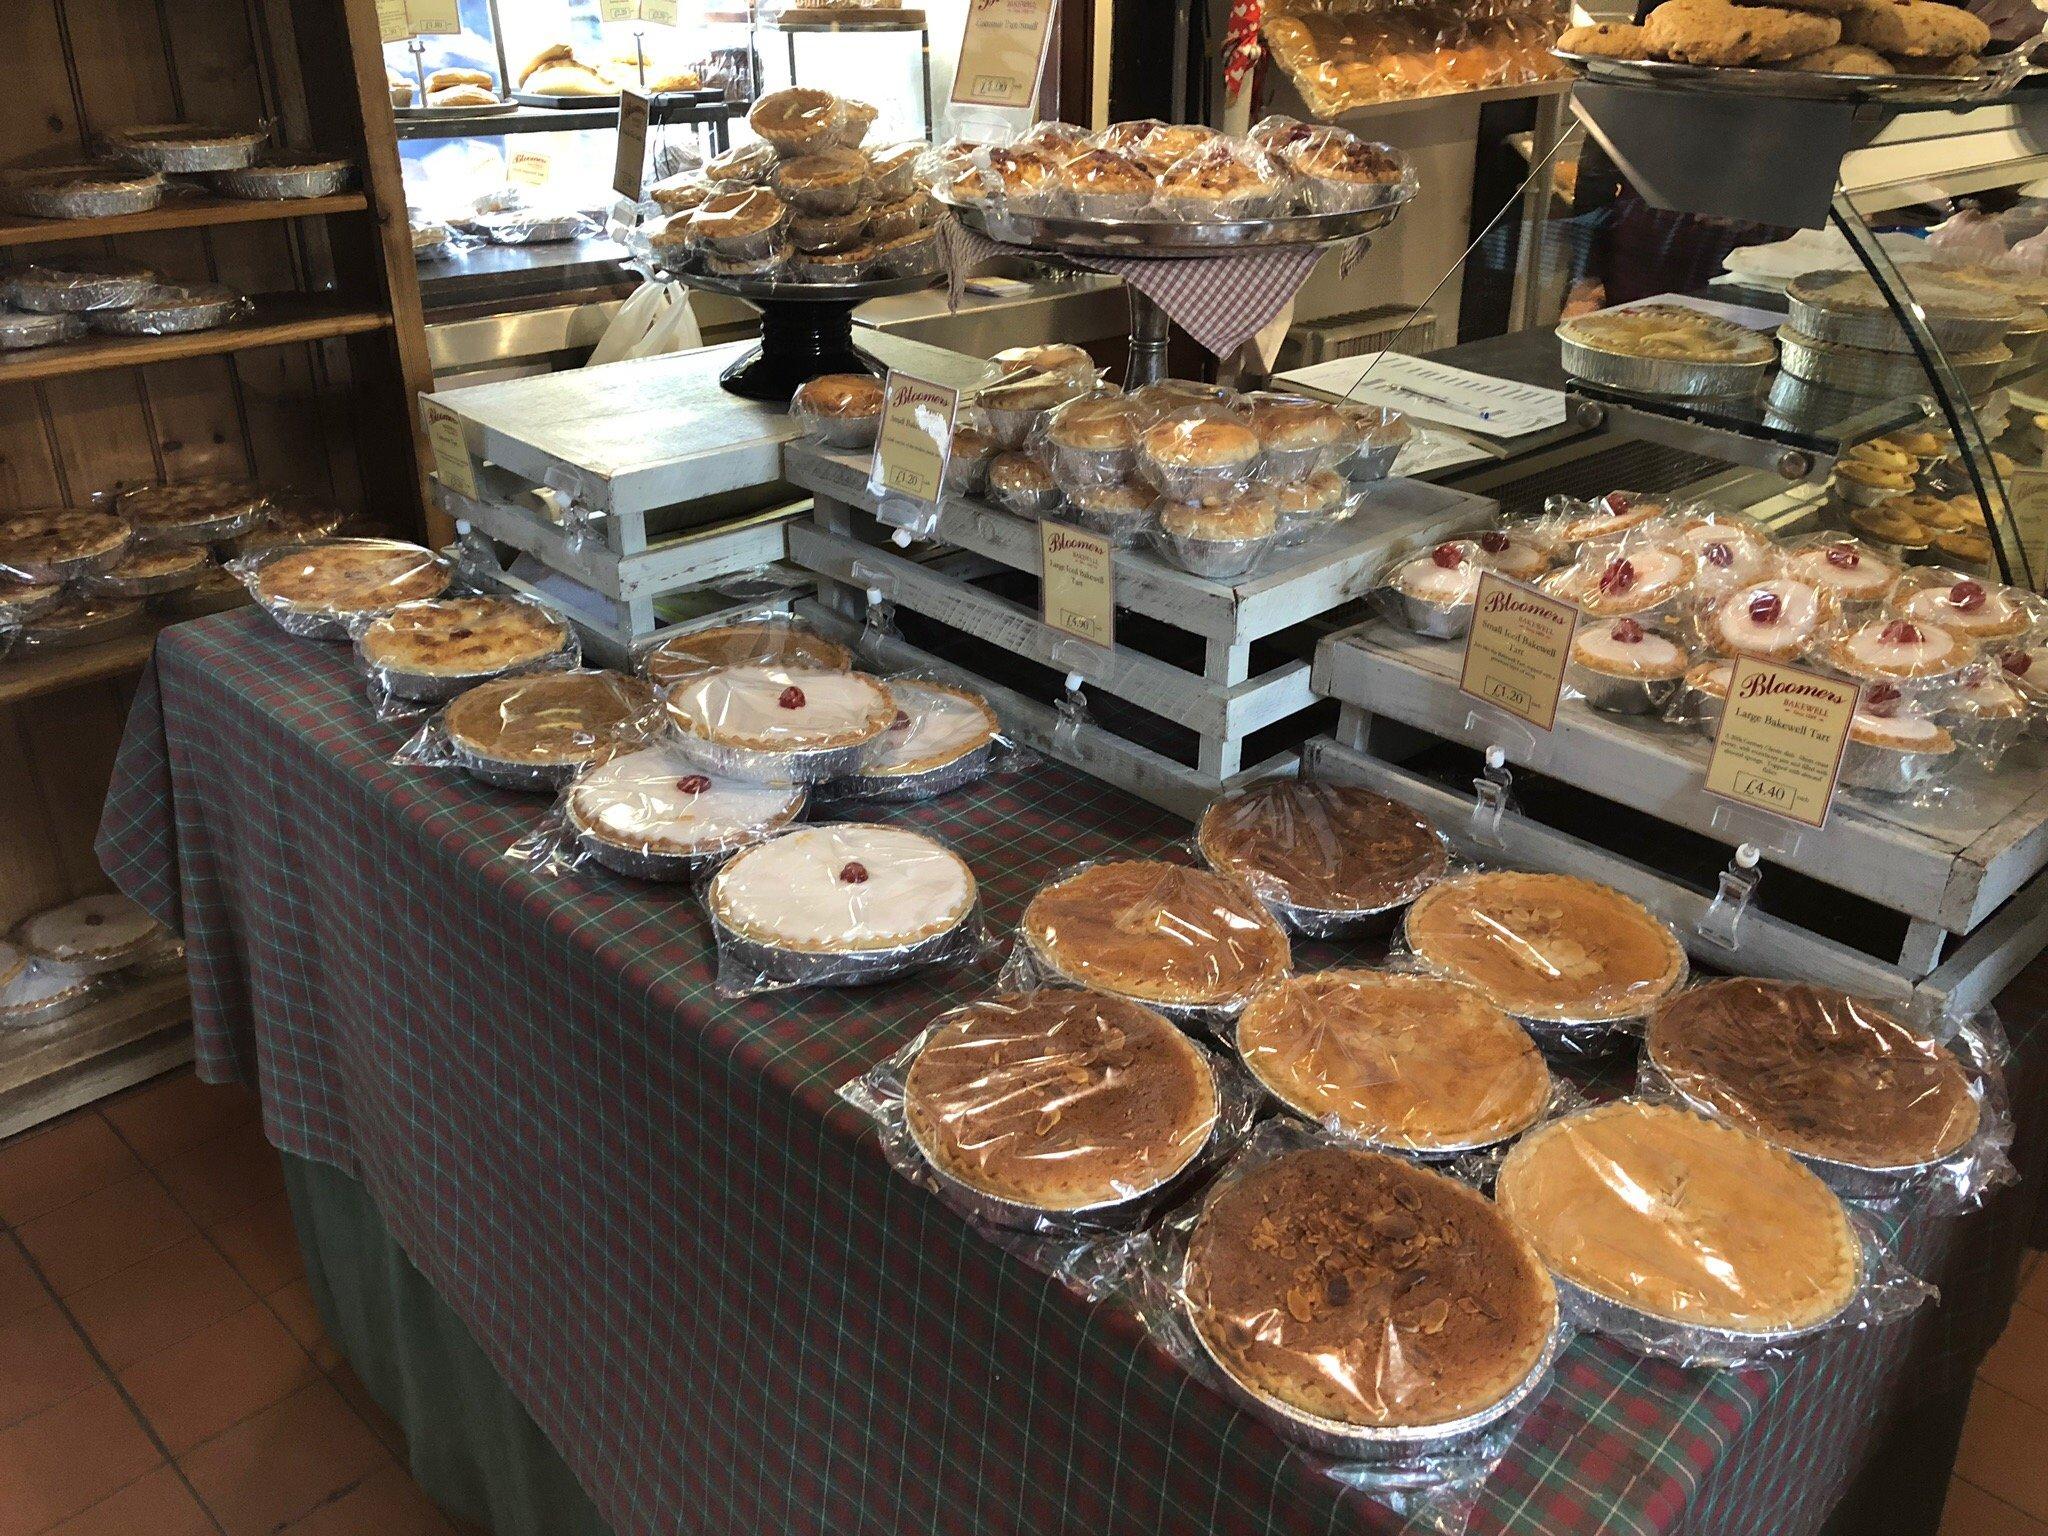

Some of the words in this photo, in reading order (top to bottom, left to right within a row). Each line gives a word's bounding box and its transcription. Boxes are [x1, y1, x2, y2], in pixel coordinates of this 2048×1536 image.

[892, 385, 950, 408] Bloomers
[1048, 533, 1105, 555] Bloomers
[1485, 591, 1565, 625] Bloomers
[1518, 616, 1554, 635] BAKEWELL
[1482, 620, 1503, 635] Small
[1504, 629, 1522, 643] Iced
[1522, 636, 1557, 658] Bakewell
[1508, 643, 1525, 657] Tart
[1492, 683, 1524, 704] £1.20
[1740, 672, 1845, 704] Bloomers
[1782, 699, 1829, 717] BAKEWELL
[1735, 707, 1762, 724] Large
[1764, 715, 1807, 736] Bakewell
[1810, 728, 1830, 743] Tart
[1744, 779, 1785, 801] £4.40
